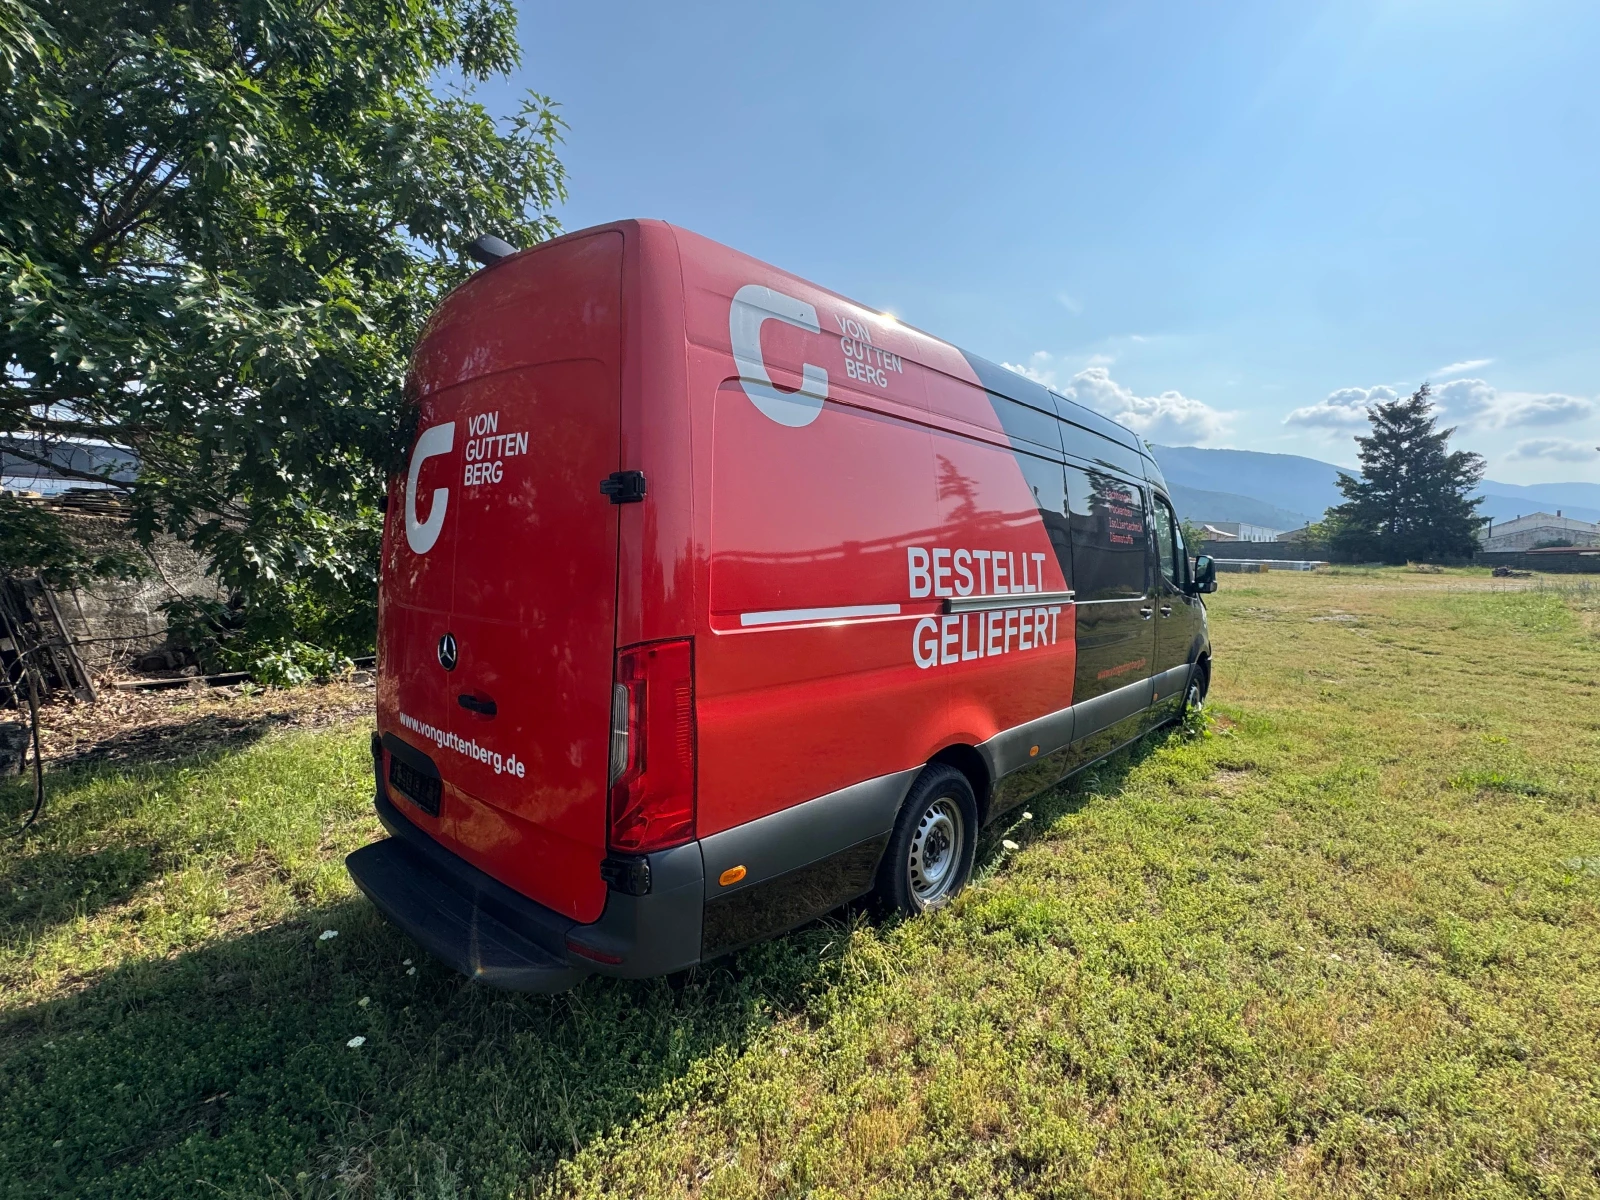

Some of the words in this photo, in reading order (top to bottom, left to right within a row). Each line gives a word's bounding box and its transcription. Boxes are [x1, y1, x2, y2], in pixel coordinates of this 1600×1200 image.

[834, 314, 871, 343] VON
[840, 337, 903, 374] GUTTEN
[845, 359, 888, 388] BERG
[469, 411, 498, 436] VON
[466, 433, 528, 461] GUTTEN
[464, 461, 503, 486] BERG
[908, 547, 1045, 598] BESTELLT
[913, 607, 1061, 669] GELIEFERT
[400, 712, 525, 778] www.vonguttenberg.de
